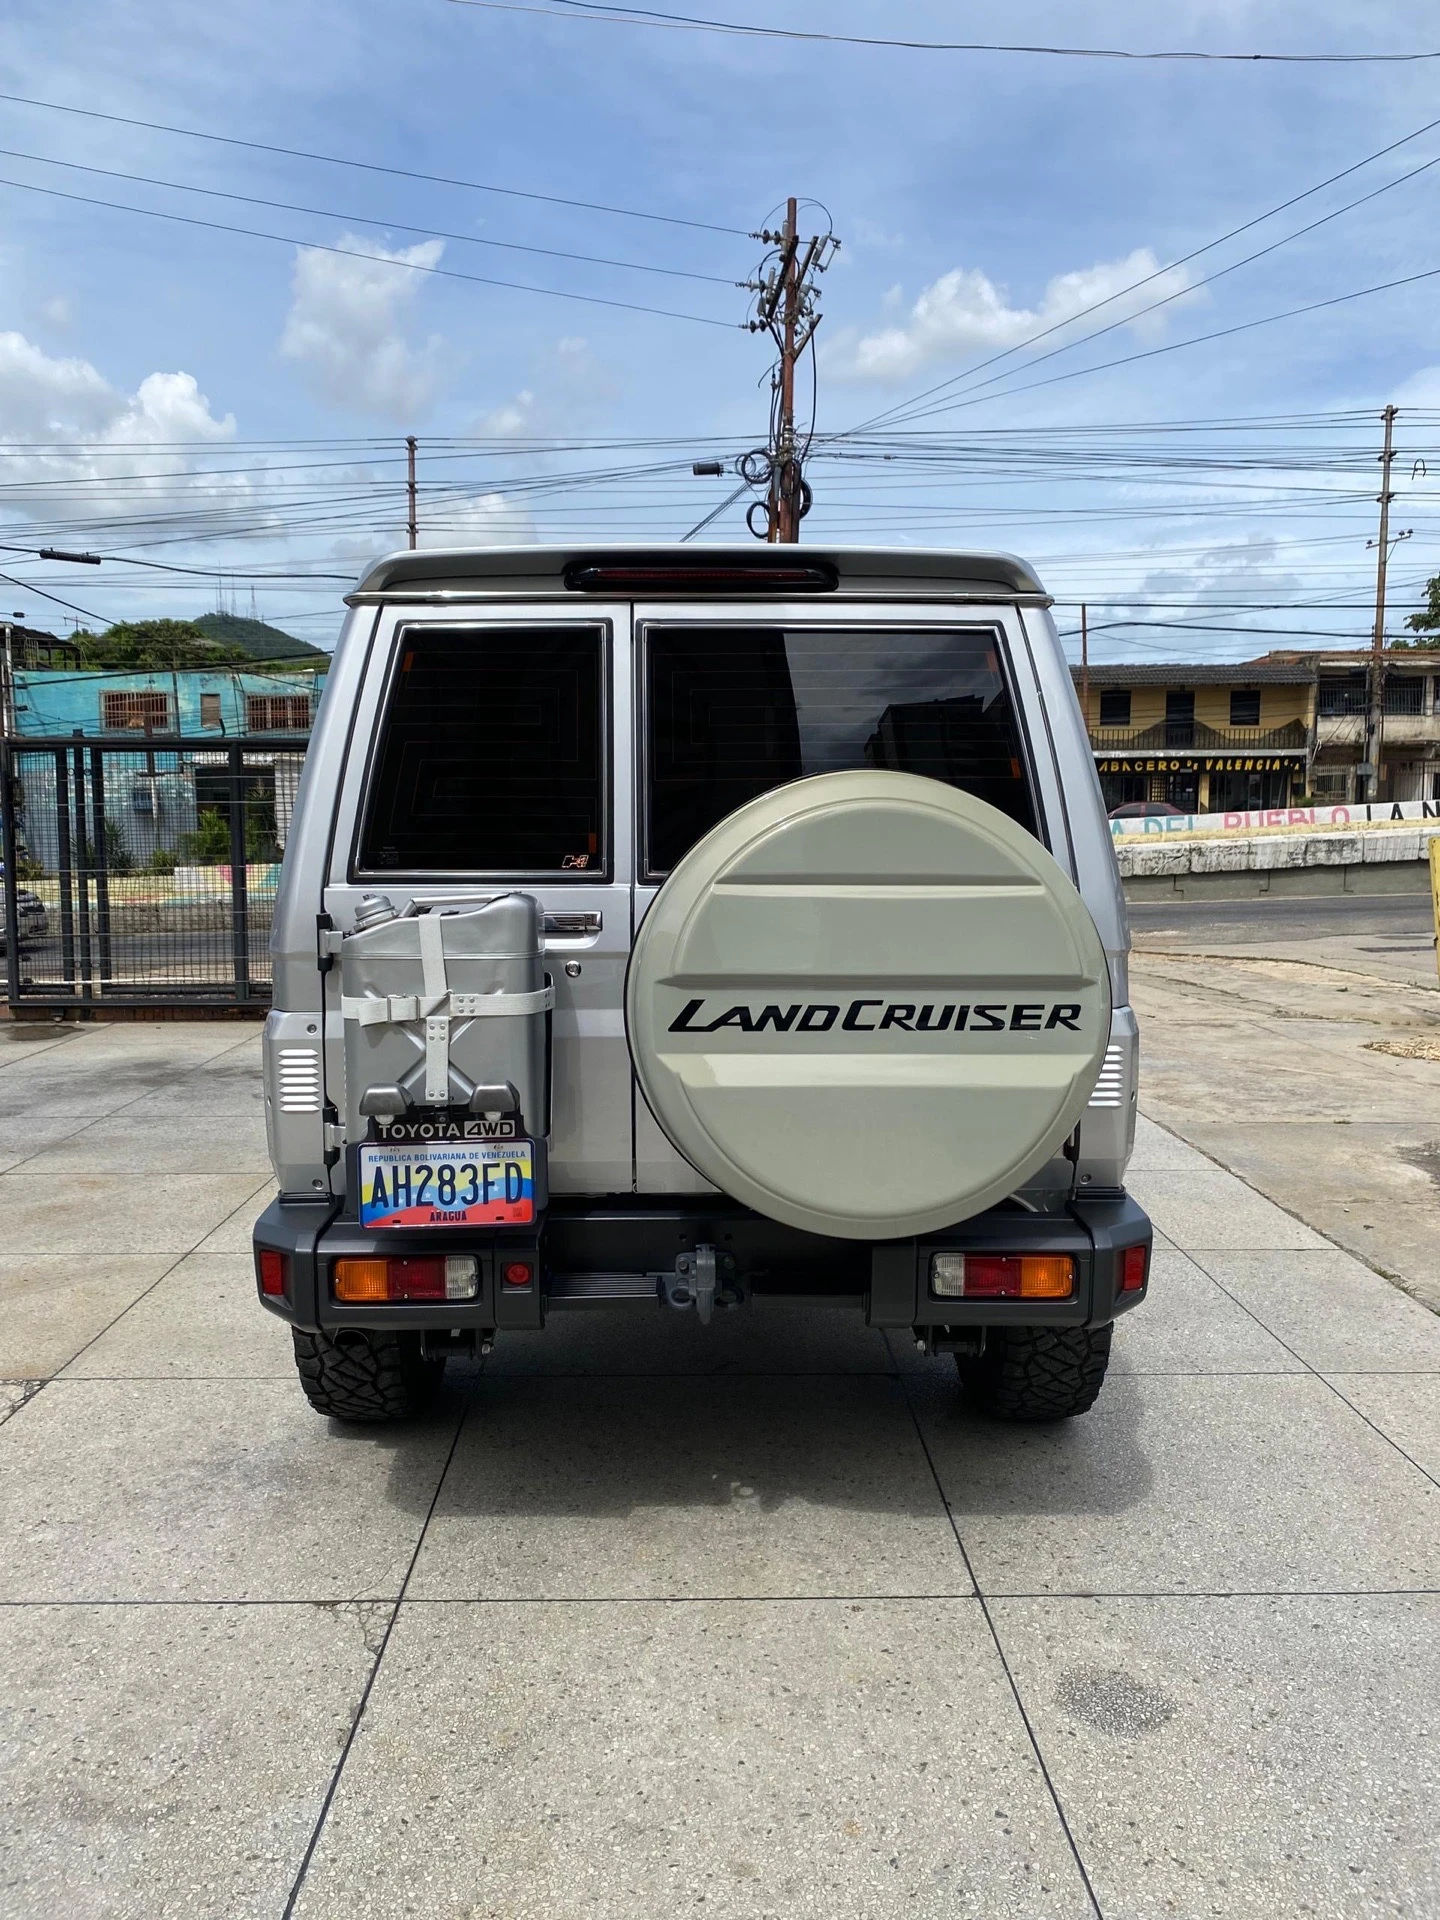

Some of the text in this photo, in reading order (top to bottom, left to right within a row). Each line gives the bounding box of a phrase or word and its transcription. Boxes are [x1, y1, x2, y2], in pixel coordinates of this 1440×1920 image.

[1206, 759, 1280, 770] VALENCIA
[379, 1121, 514, 1138] TOYOTA 4WD
[368, 1151, 526, 1162] REPUBLICA BOLIVARIANA DE VENEZUELA
[370, 1162, 524, 1209] AH283FD
[429, 1210, 467, 1222] ARAGUA
